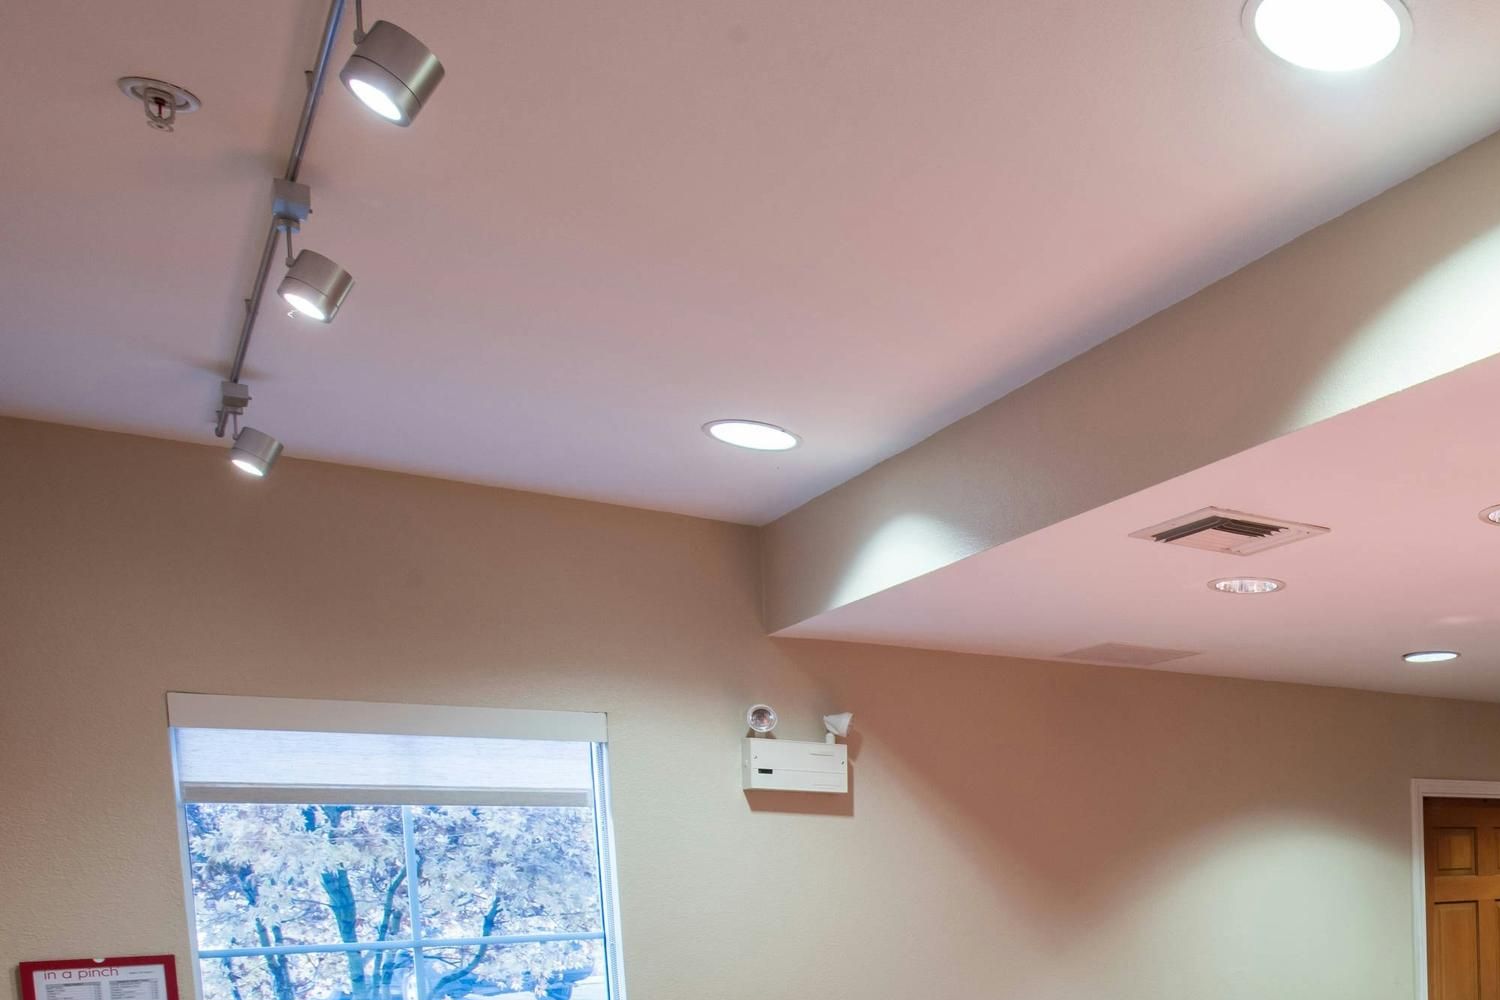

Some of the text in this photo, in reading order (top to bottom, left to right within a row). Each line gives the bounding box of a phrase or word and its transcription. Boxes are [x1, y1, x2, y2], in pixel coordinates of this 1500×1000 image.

[43, 970, 57, 980] in
[62, 971, 73, 979] a
[77, 966, 119, 980] pinch
